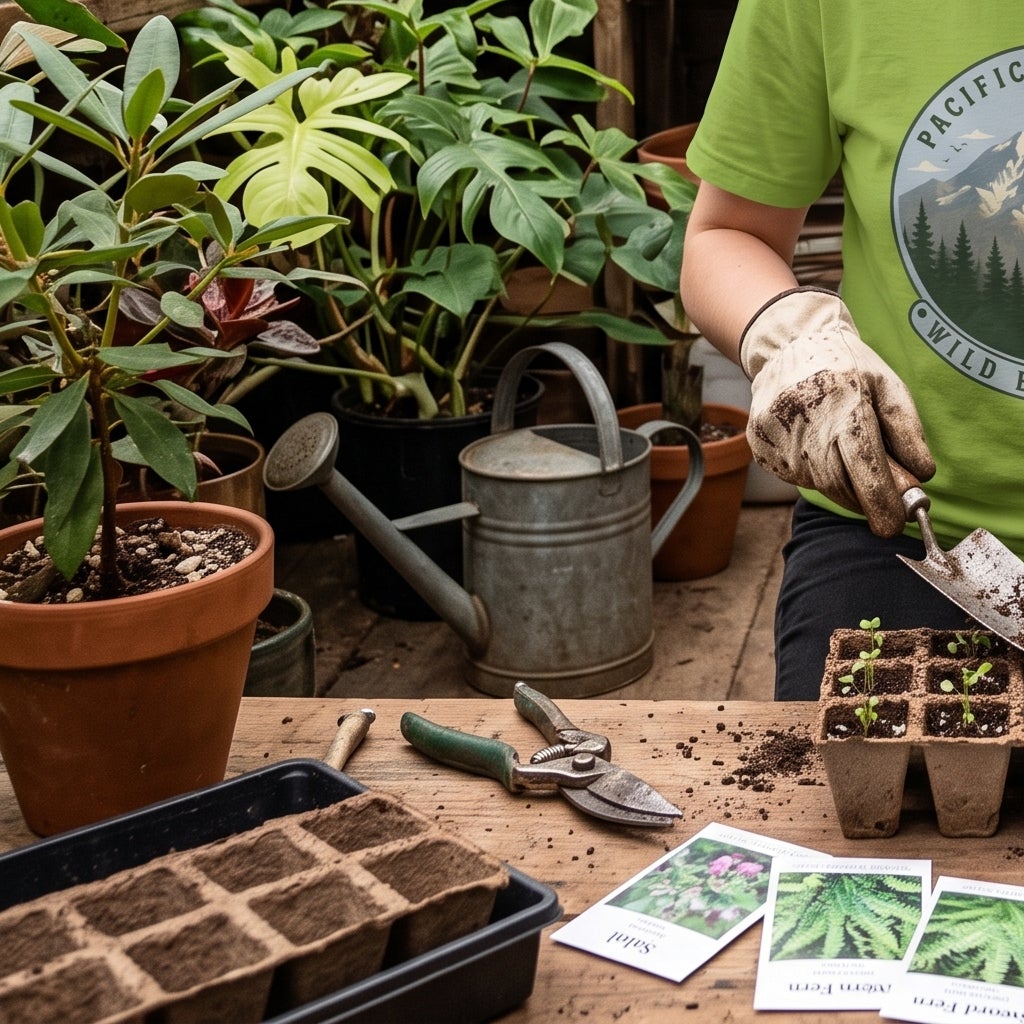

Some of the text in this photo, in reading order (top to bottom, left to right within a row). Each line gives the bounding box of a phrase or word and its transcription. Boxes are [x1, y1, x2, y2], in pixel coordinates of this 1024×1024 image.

[917, 60, 1024, 149] PACIFIC
[926, 319, 998, 380] WILD
[913, 996, 957, 1014] Fern
